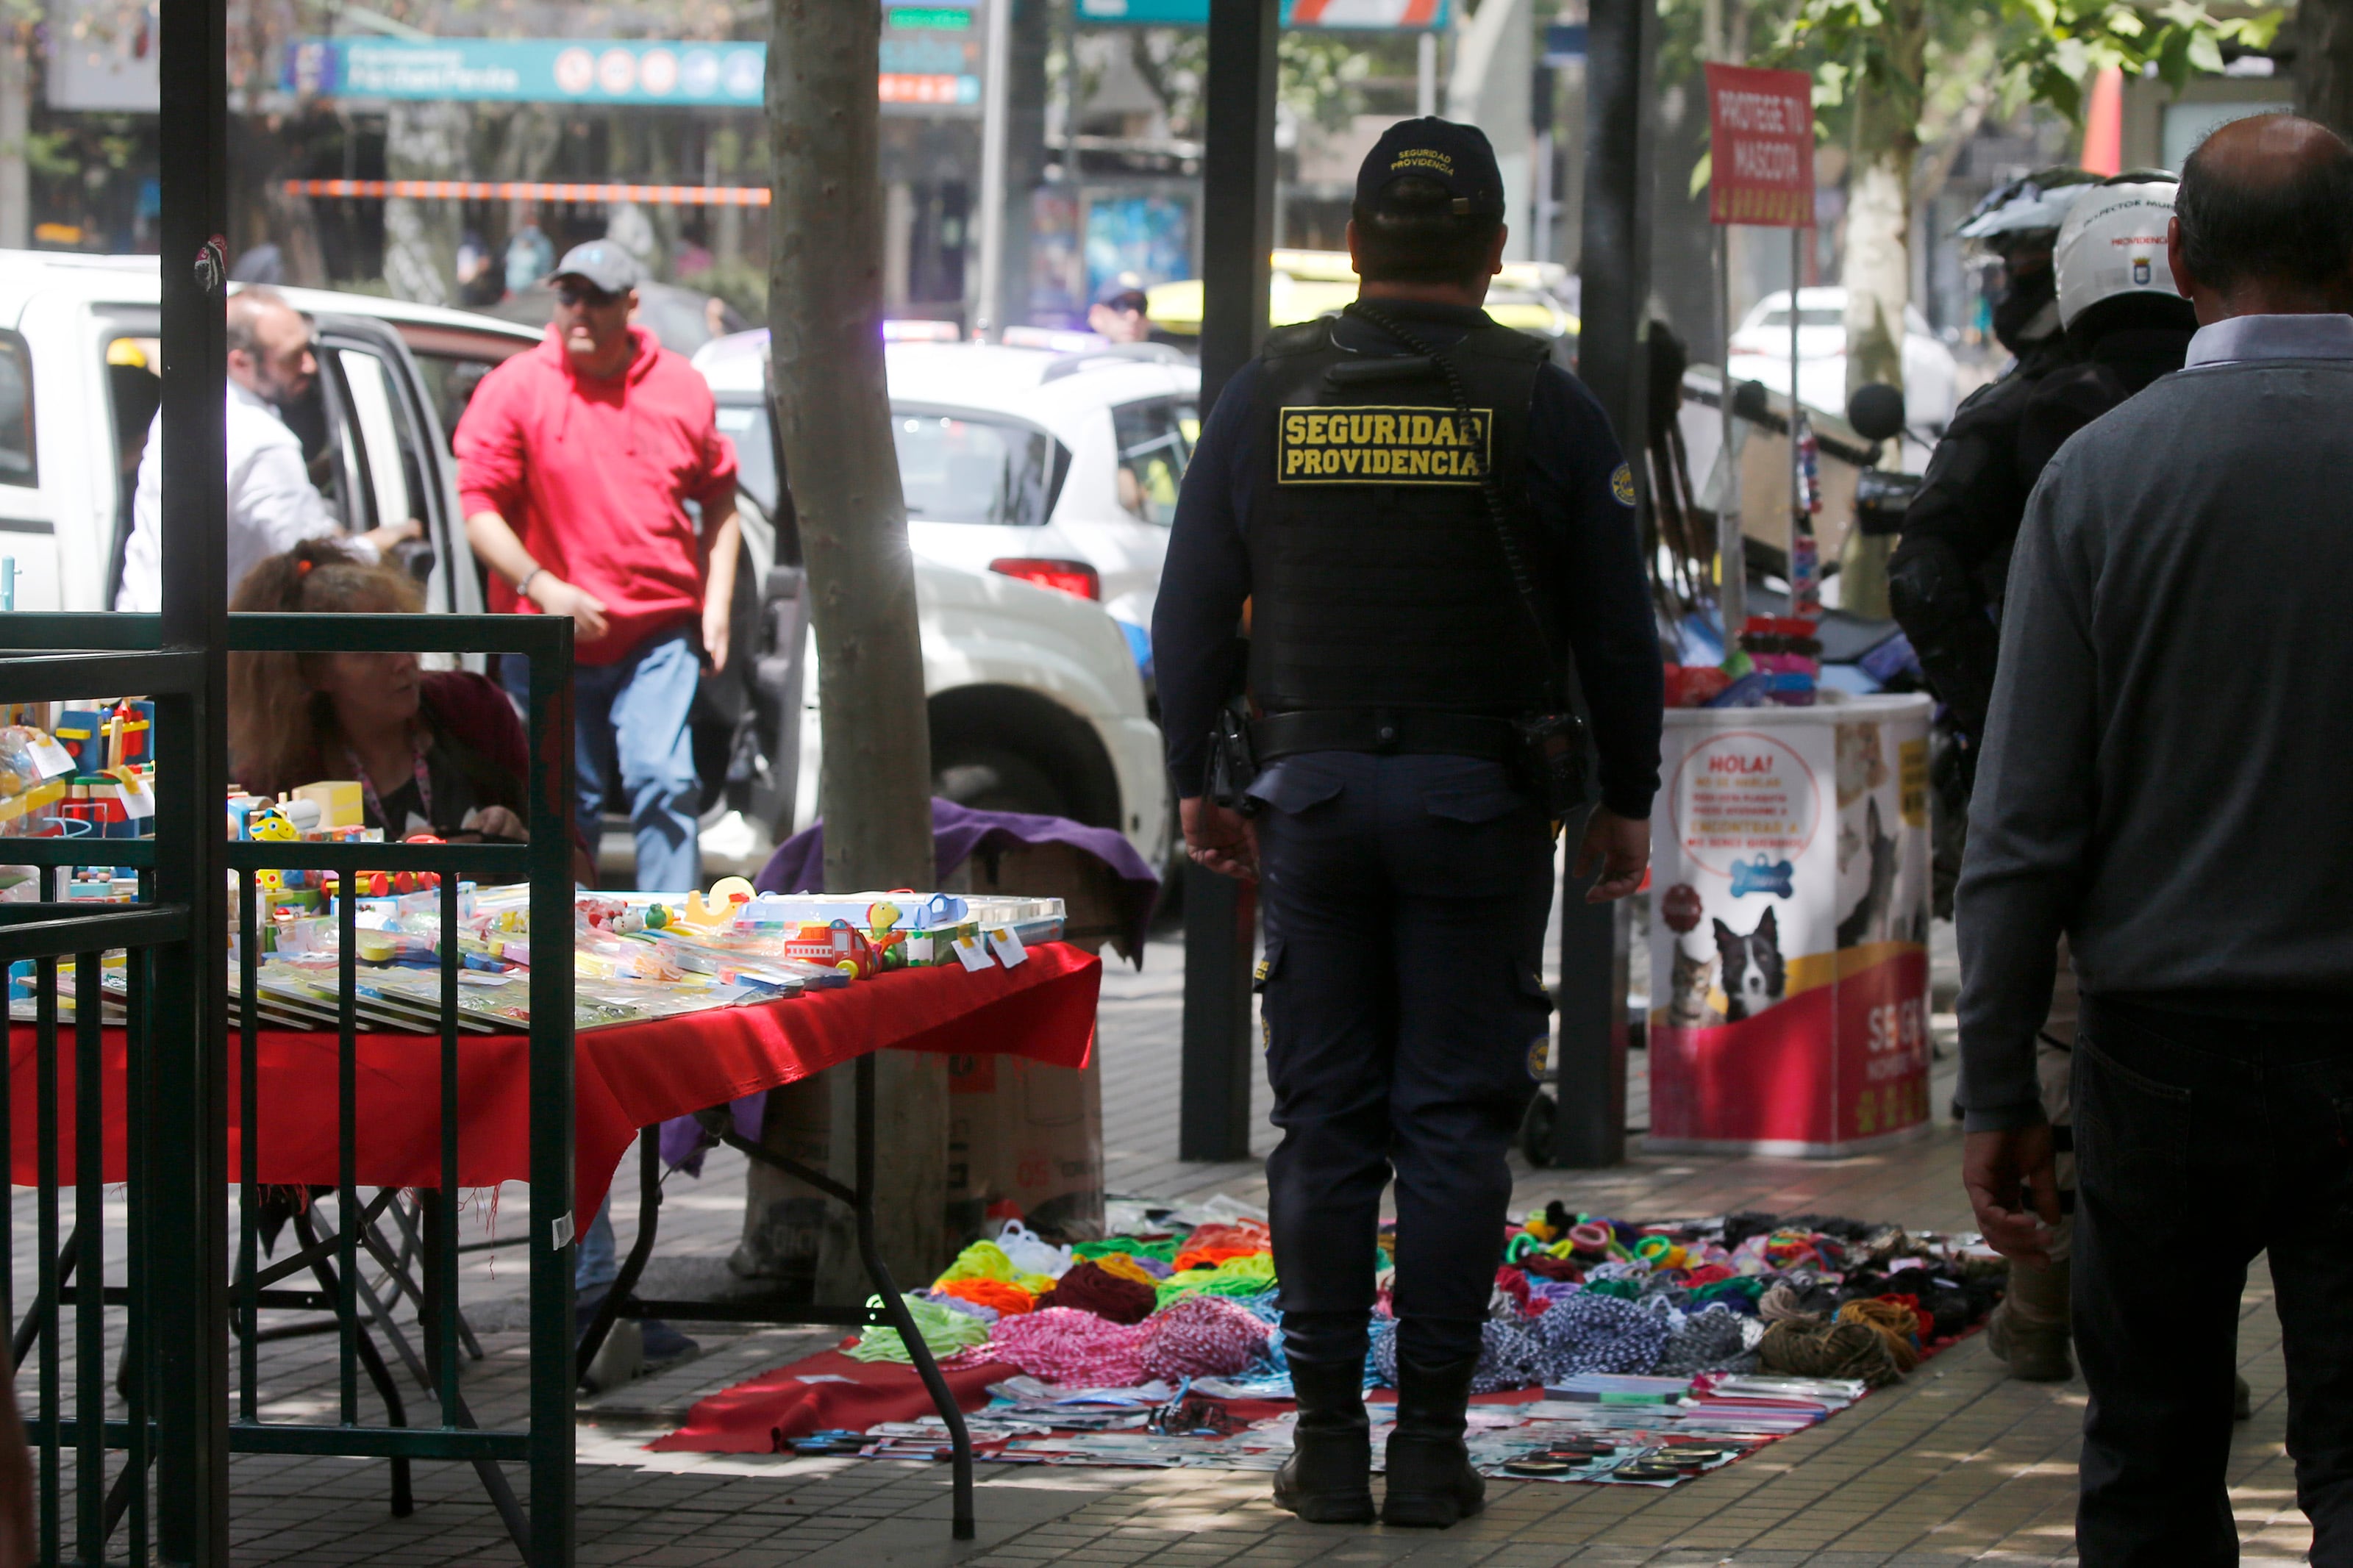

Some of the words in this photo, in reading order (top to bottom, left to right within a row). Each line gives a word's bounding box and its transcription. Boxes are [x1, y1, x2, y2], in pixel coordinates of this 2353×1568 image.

[1399, 148, 1452, 163] SEGURIDAD
[1390, 158, 1455, 176] PROVIDENCIA
[1286, 415, 1482, 445] SEGURIDAD
[1286, 449, 1480, 476] PROVIDENCIA
[1708, 755, 1774, 774] HOLA!
